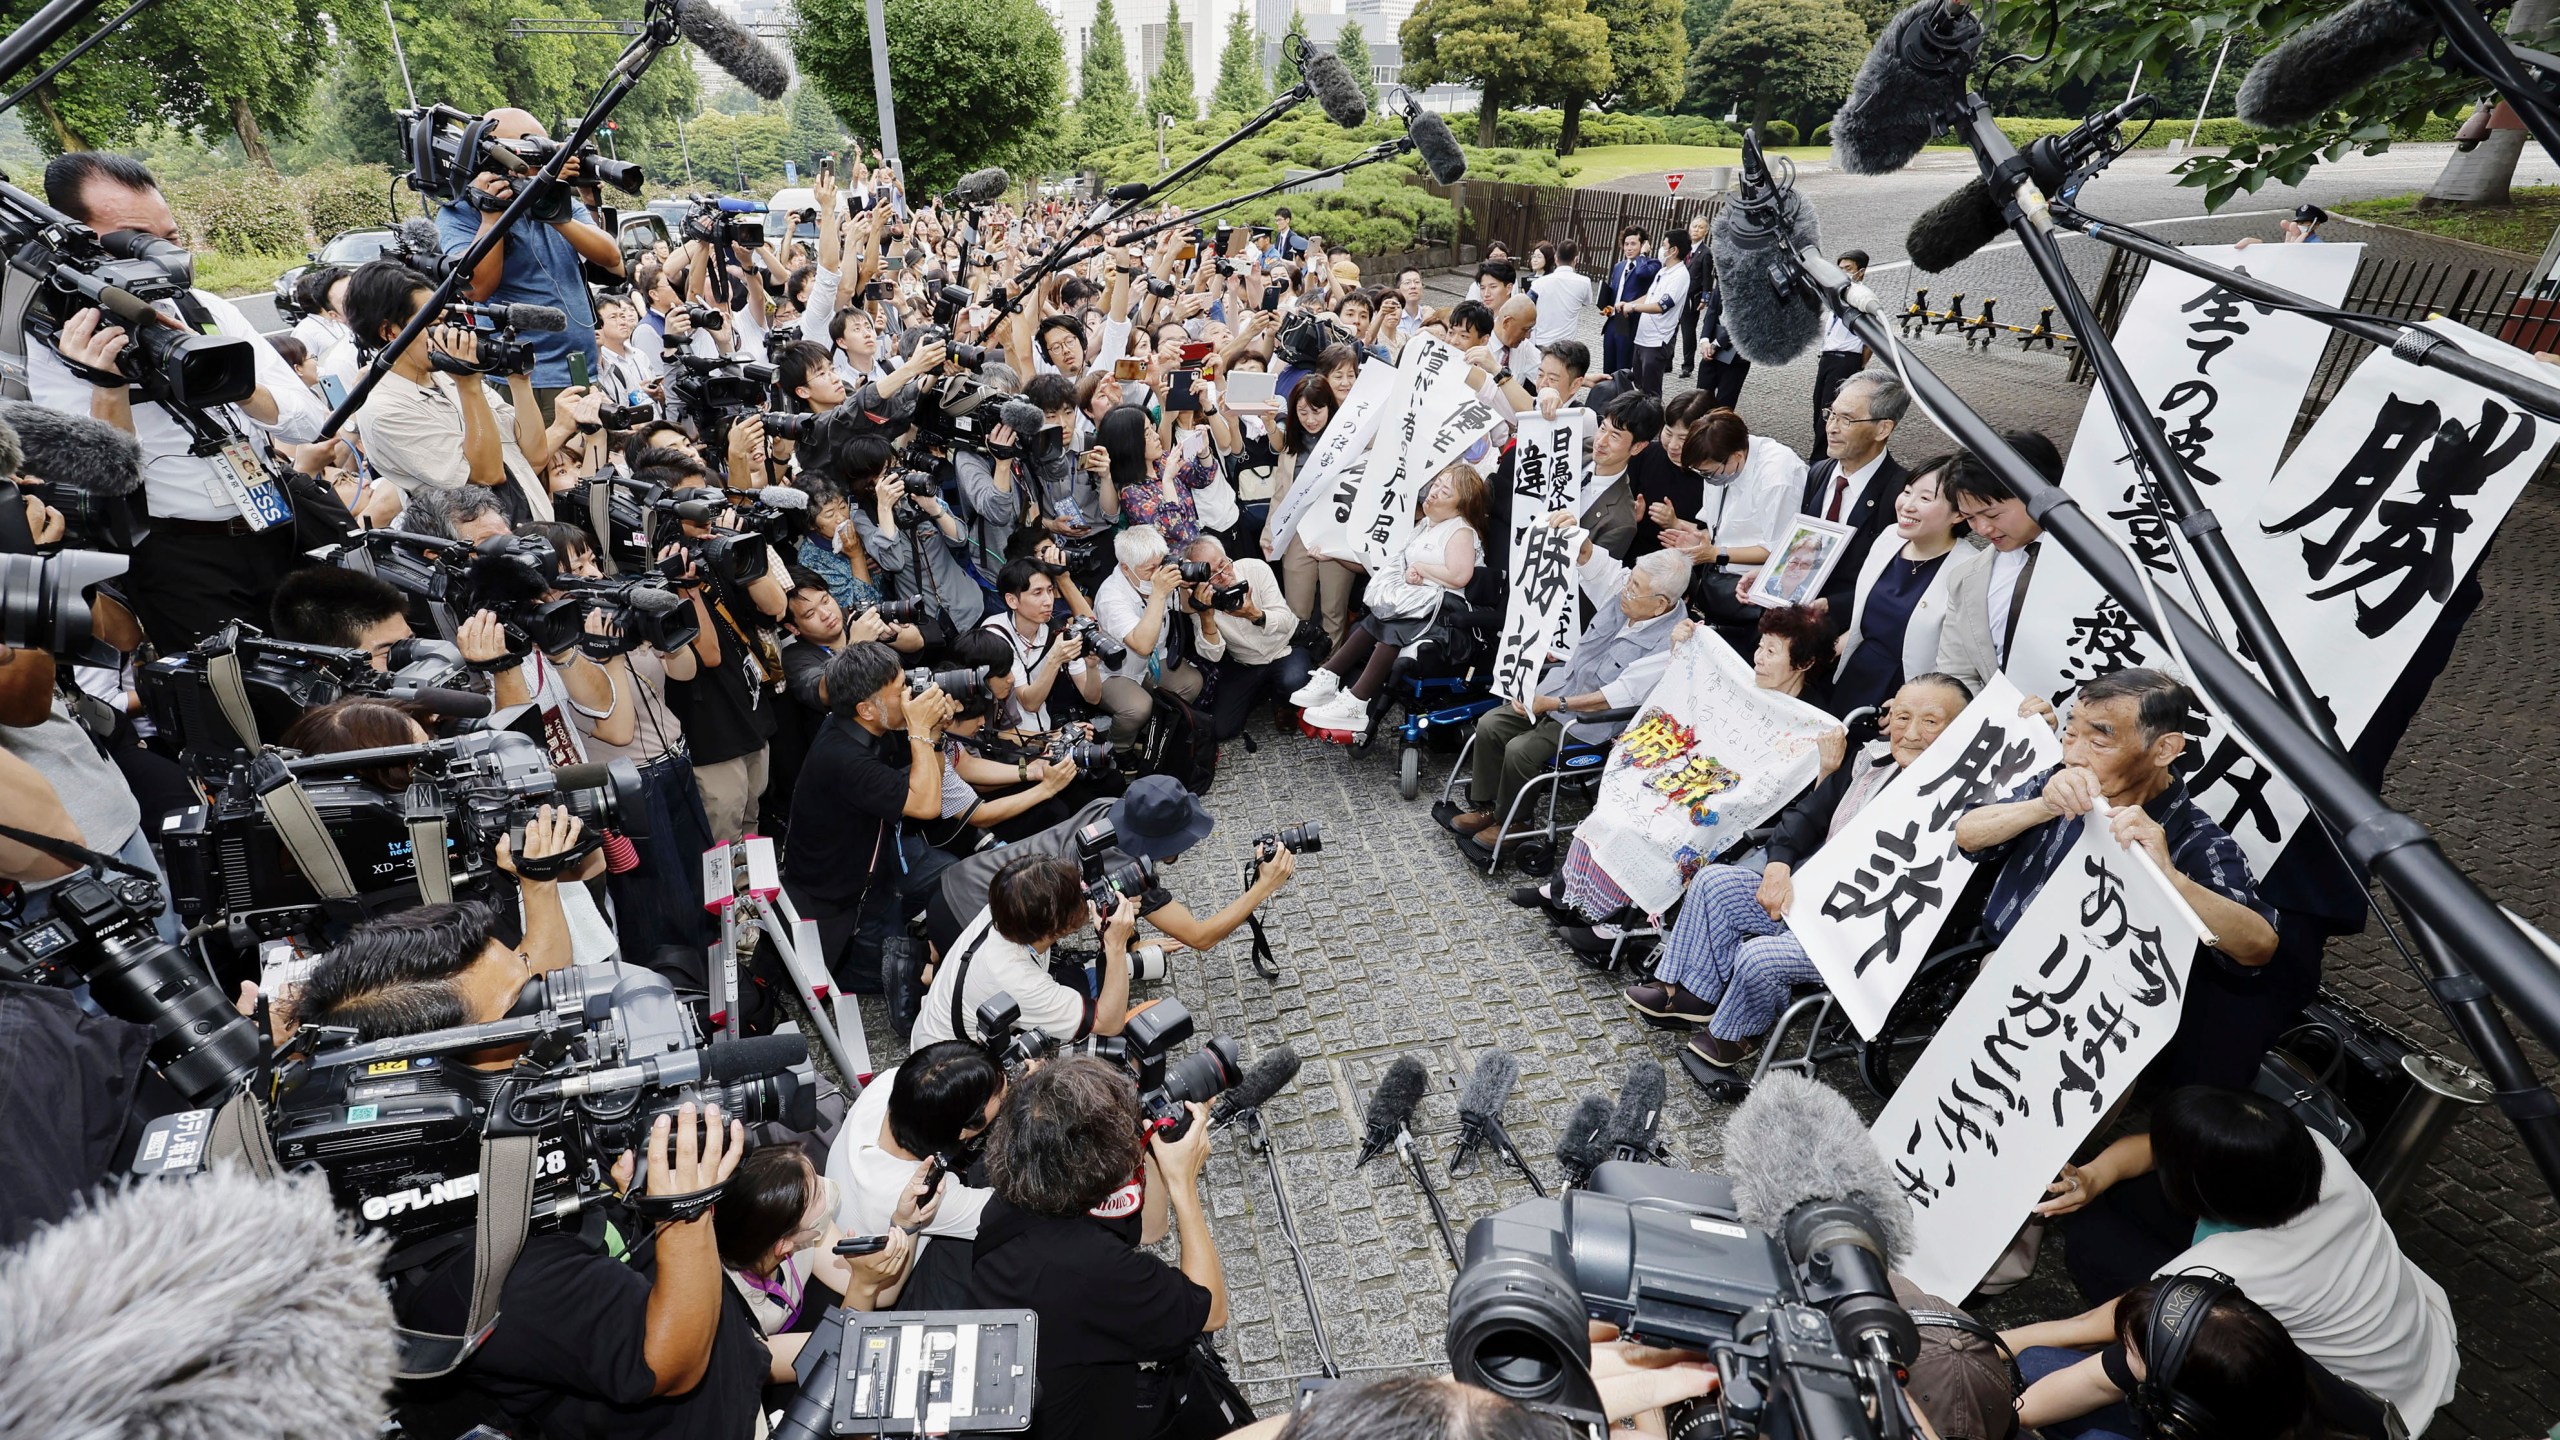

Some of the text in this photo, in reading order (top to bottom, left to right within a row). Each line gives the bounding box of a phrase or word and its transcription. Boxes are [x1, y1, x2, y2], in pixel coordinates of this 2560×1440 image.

[1365, 339, 1449, 572] 障がい者の声が届い
[2051, 264, 2278, 708] 全ての被害救
[1499, 525, 1580, 703] 勝訴
[544, 724, 570, 767] 共同通
[95, 918, 129, 939] Nikon
[388, 841, 401, 850] tv
[1821, 717, 2036, 979] 勝訴
[2050, 924, 2181, 1128] 今まで
[672, 1190, 723, 1209] FUJINON
